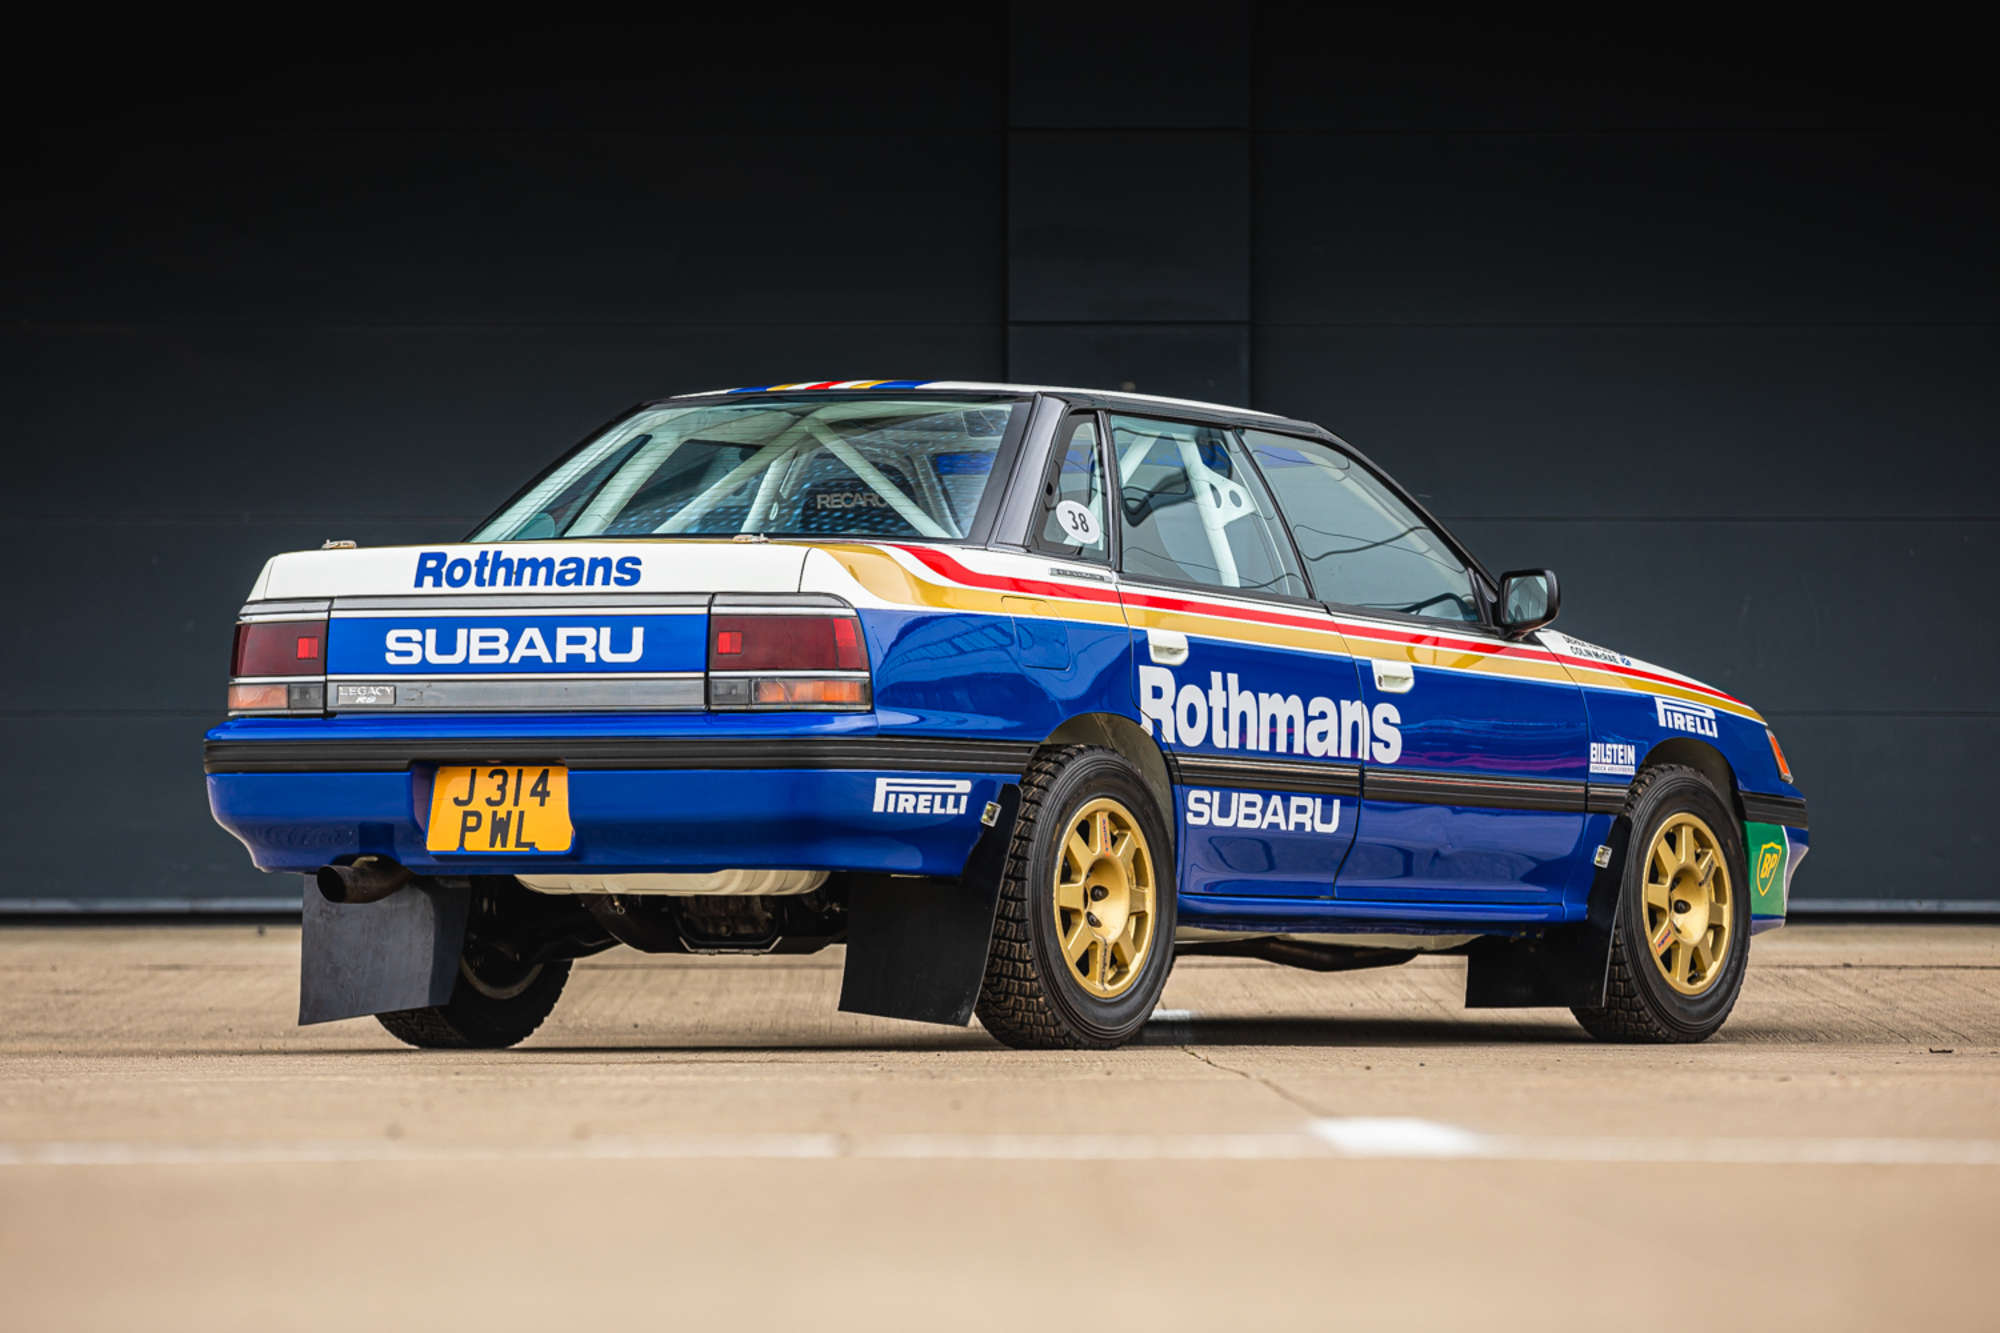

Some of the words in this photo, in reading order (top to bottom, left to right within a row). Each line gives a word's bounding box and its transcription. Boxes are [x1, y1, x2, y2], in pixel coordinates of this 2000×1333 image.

[1067, 510, 1090, 533] 38
[414, 550, 642, 588] Rothmans
[385, 626, 644, 665] SUBARU
[339, 686, 393, 696] LEGACY
[1139, 664, 1402, 764] Rothmans
[1655, 697, 1718, 738] PIRELLI
[1590, 742, 1636, 765] BILSTEIN
[453, 768, 551, 807] J314
[873, 777, 971, 815] PIRELLI
[460, 810, 535, 849] PWL
[1186, 790, 1340, 833] SUBARU
[1760, 853, 1778, 879] BP
